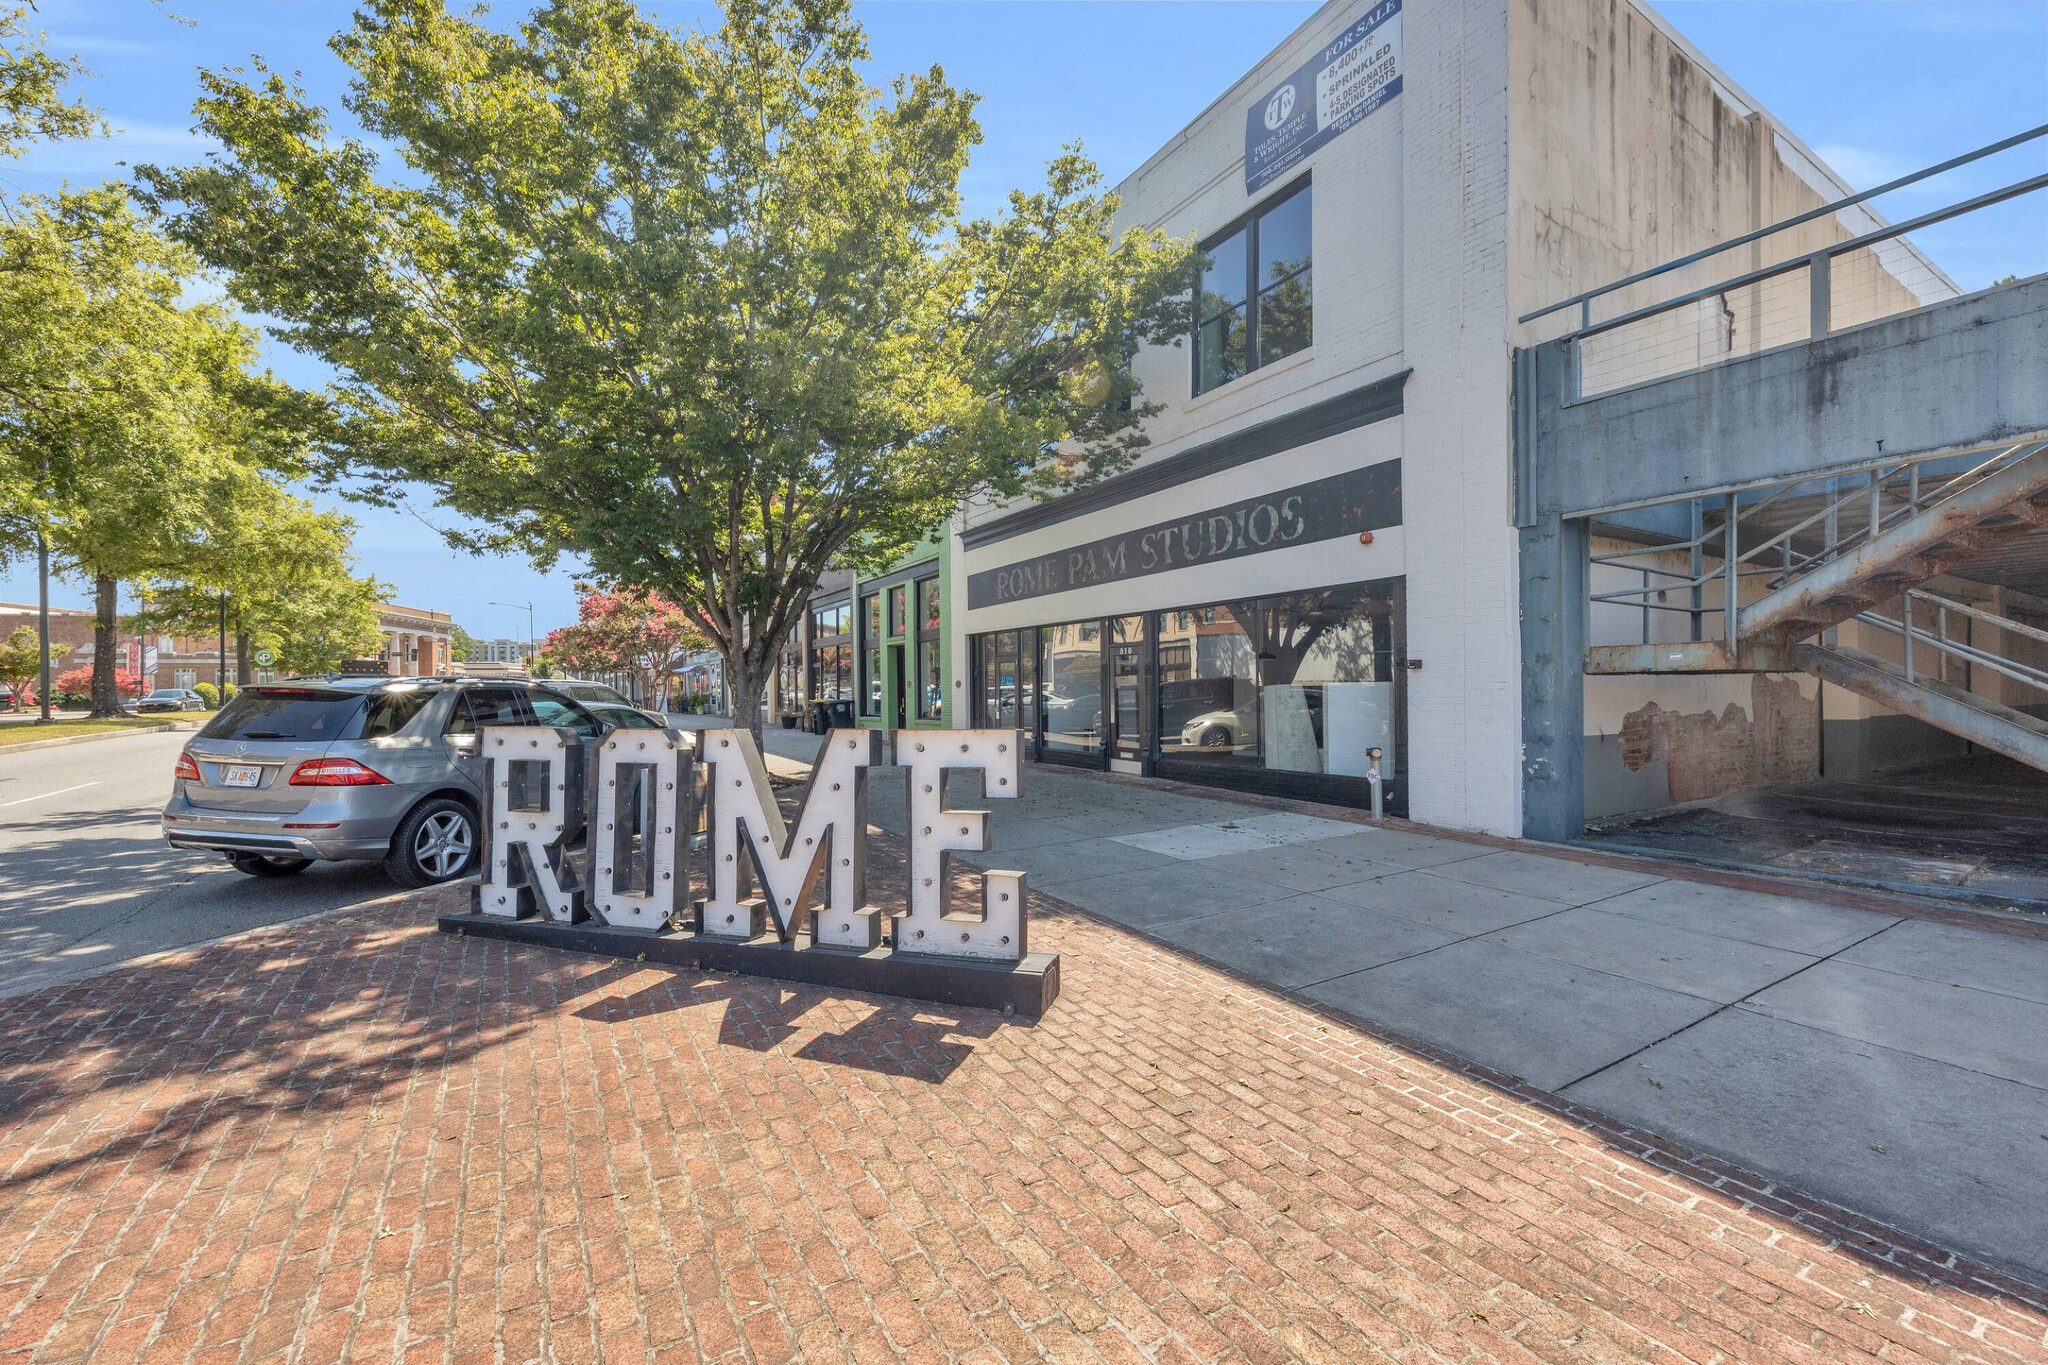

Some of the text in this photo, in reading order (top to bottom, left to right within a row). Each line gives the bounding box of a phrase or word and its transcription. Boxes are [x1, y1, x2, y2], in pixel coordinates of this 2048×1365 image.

[1325, 1, 1396, 62] FOR SALE
[1329, 44, 1391, 95] SPRINKLED
[1330, 67, 1396, 119] PARKING SPOTS
[1343, 56, 1395, 100] DESIGNATED
[1278, 112, 1307, 137] TEMPLE
[1331, 88, 1387, 131] DEBRA McDANIEL
[997, 496, 1304, 600] ROME PAM STUDIOS
[1367, 772, 1379, 780] FDC
[476, 728, 1027, 961] ROME
